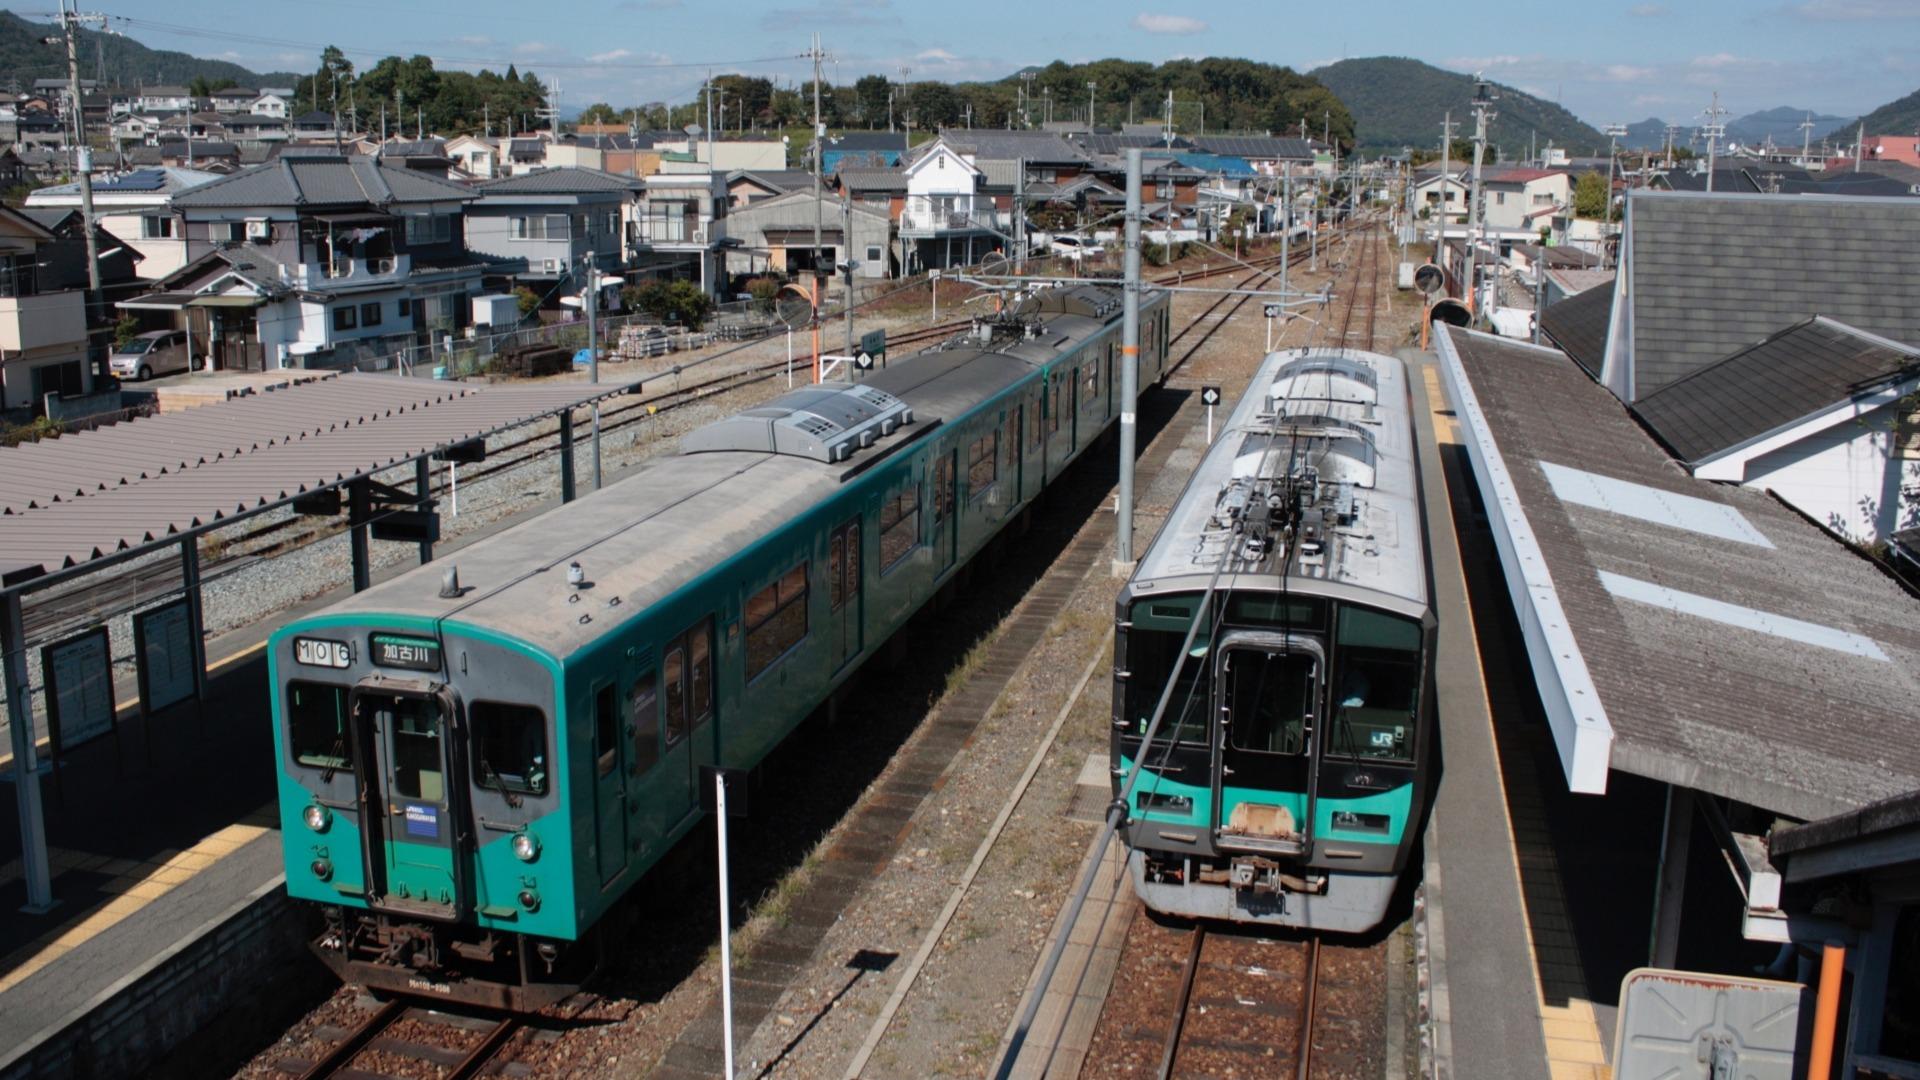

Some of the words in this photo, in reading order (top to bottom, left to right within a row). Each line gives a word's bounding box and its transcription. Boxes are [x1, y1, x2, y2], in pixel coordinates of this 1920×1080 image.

[383, 643, 429, 663] 加古川
[1372, 732, 1394, 745] JR
